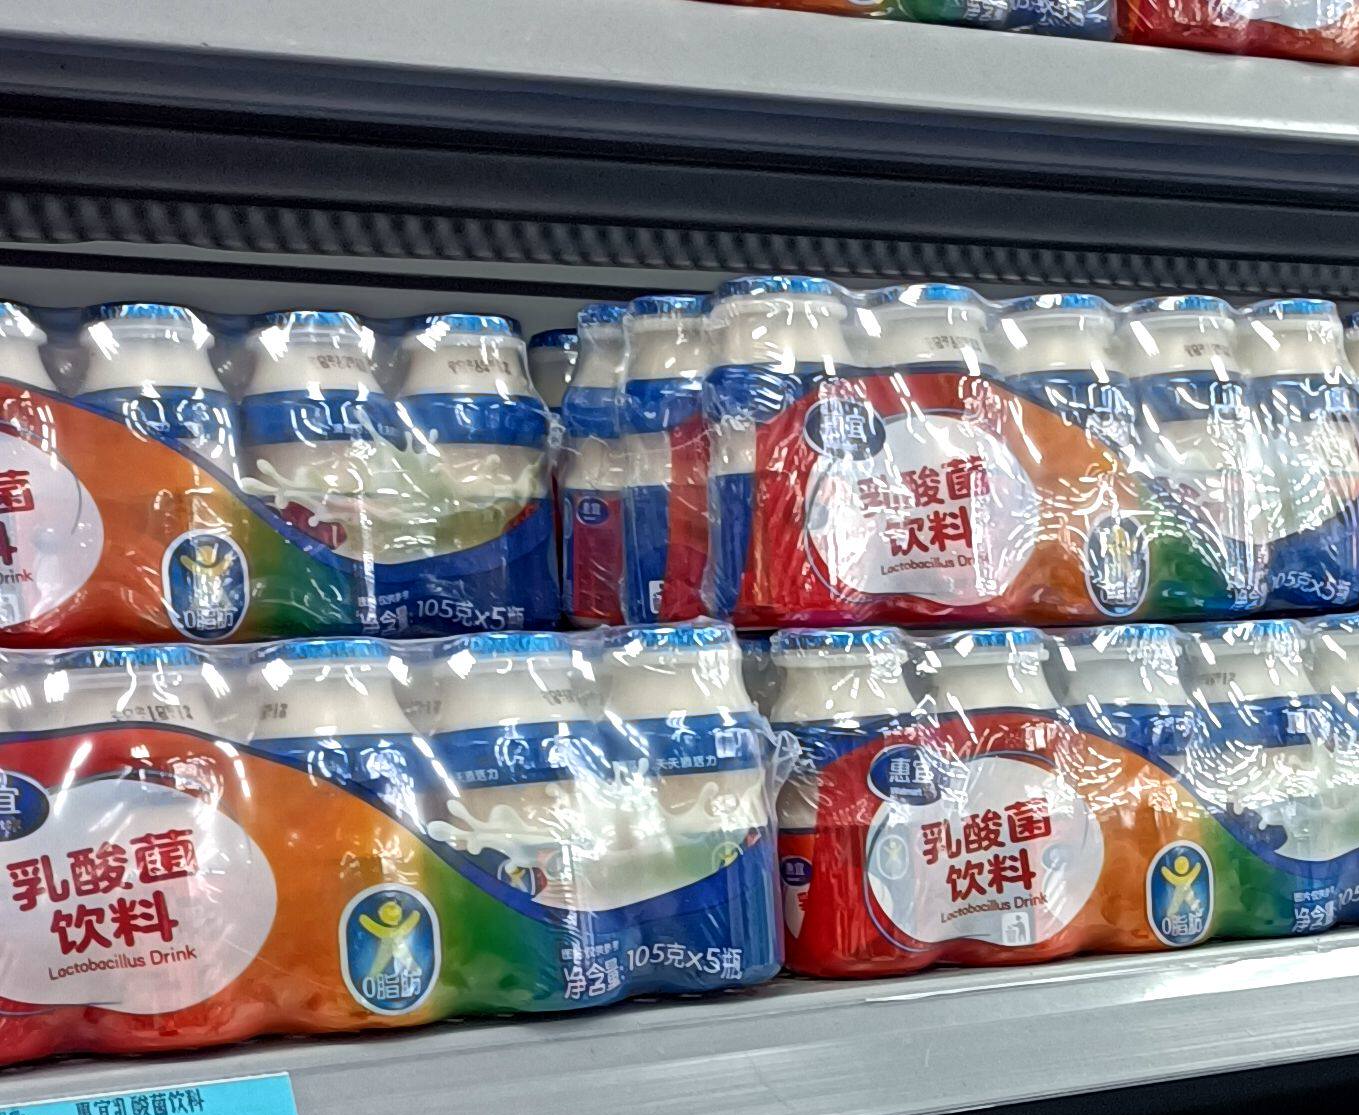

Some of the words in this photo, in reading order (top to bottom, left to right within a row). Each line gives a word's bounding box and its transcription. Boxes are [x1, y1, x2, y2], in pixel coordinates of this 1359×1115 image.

[882, 506, 974, 556] 饮料
[921, 797, 1053, 866] 乳酸菌
[7, 829, 196, 913] 乳酸菌
[946, 848, 1037, 902] 饮料
[50, 890, 179, 956] 饮料
[940, 902, 1011, 924] Lactobacillus
[1014, 893, 1048, 911] Drink
[48, 955, 147, 981] Lactobacillus
[150, 945, 197, 966] Drink
